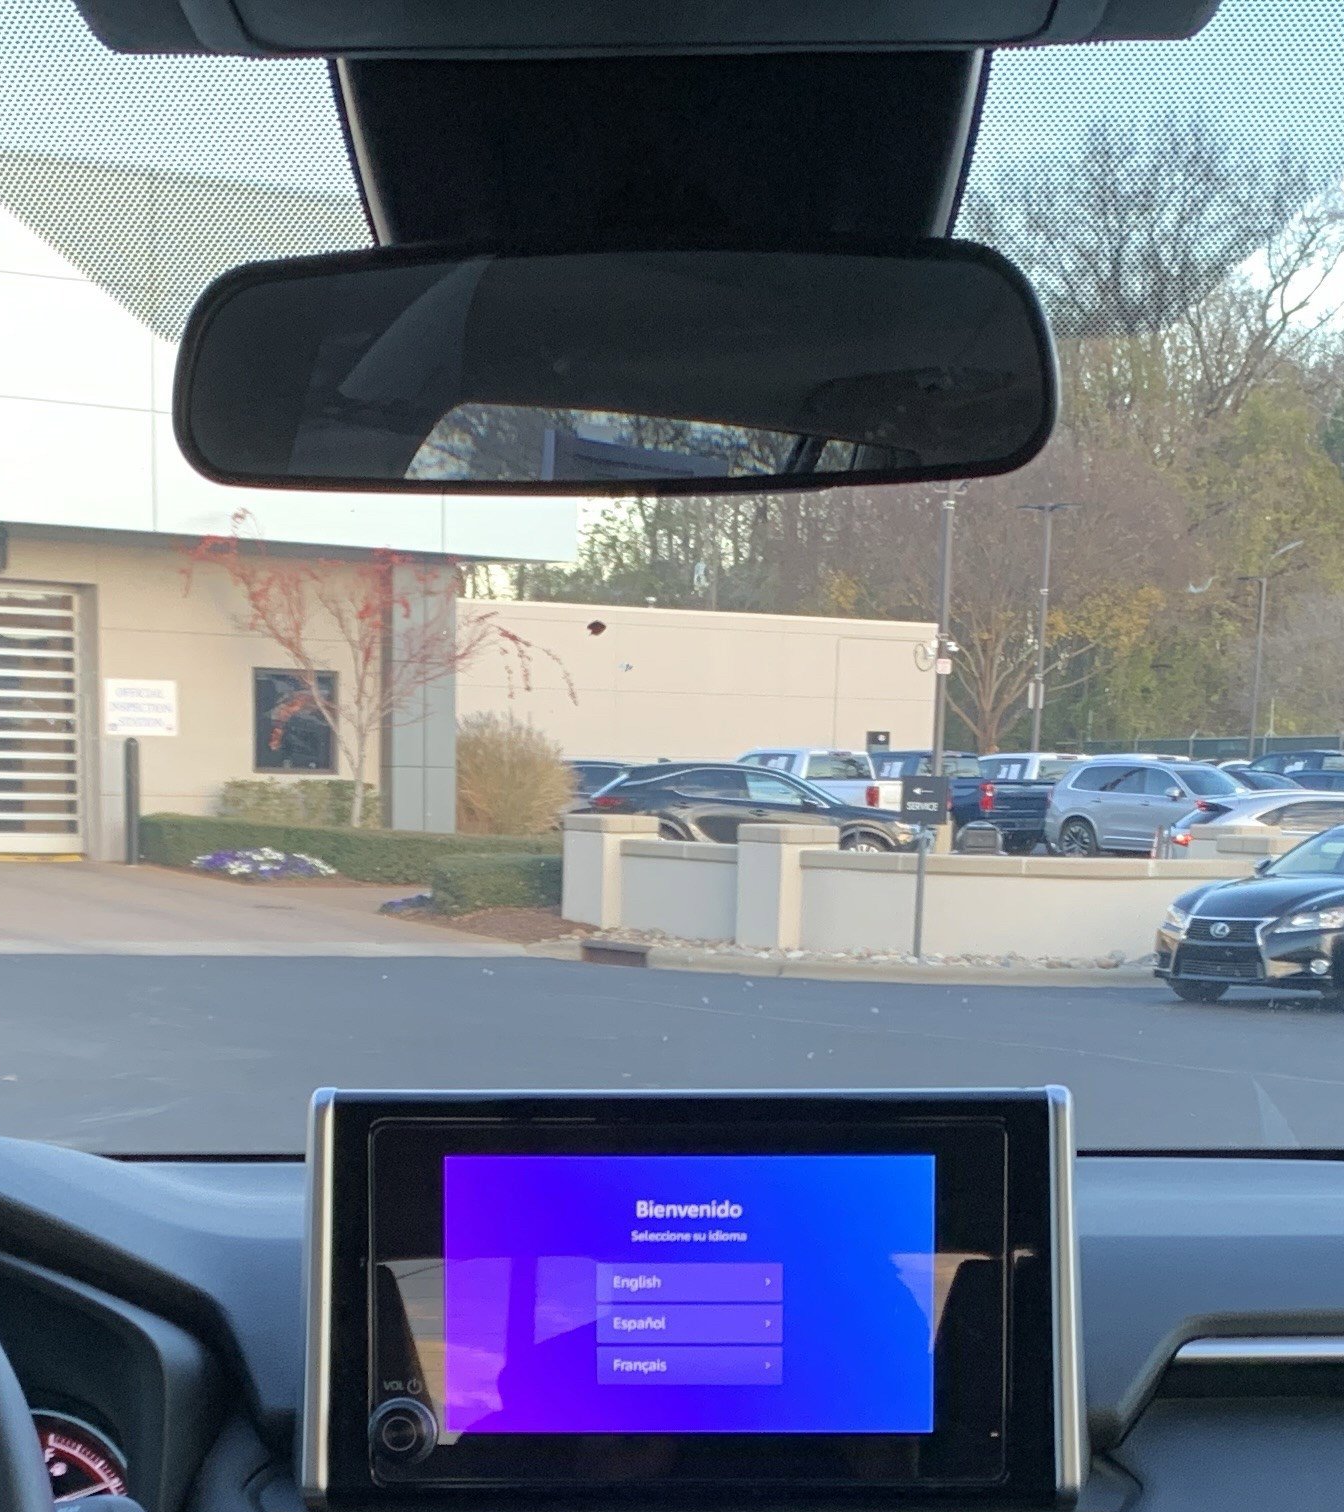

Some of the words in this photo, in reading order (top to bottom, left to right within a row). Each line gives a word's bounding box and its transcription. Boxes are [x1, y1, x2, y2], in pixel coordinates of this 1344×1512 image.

[906, 801, 939, 812] SERVICE
[635, 1199, 743, 1219] Bienvenido
[630, 1230, 692, 1243] Seleccione
[693, 1231, 707, 1242] su
[708, 1230, 748, 1242] idioma
[612, 1276, 662, 1292] English
[612, 1316, 666, 1332] Español
[612, 1357, 668, 1376] Français
[383, 1380, 404, 1391] VOL
